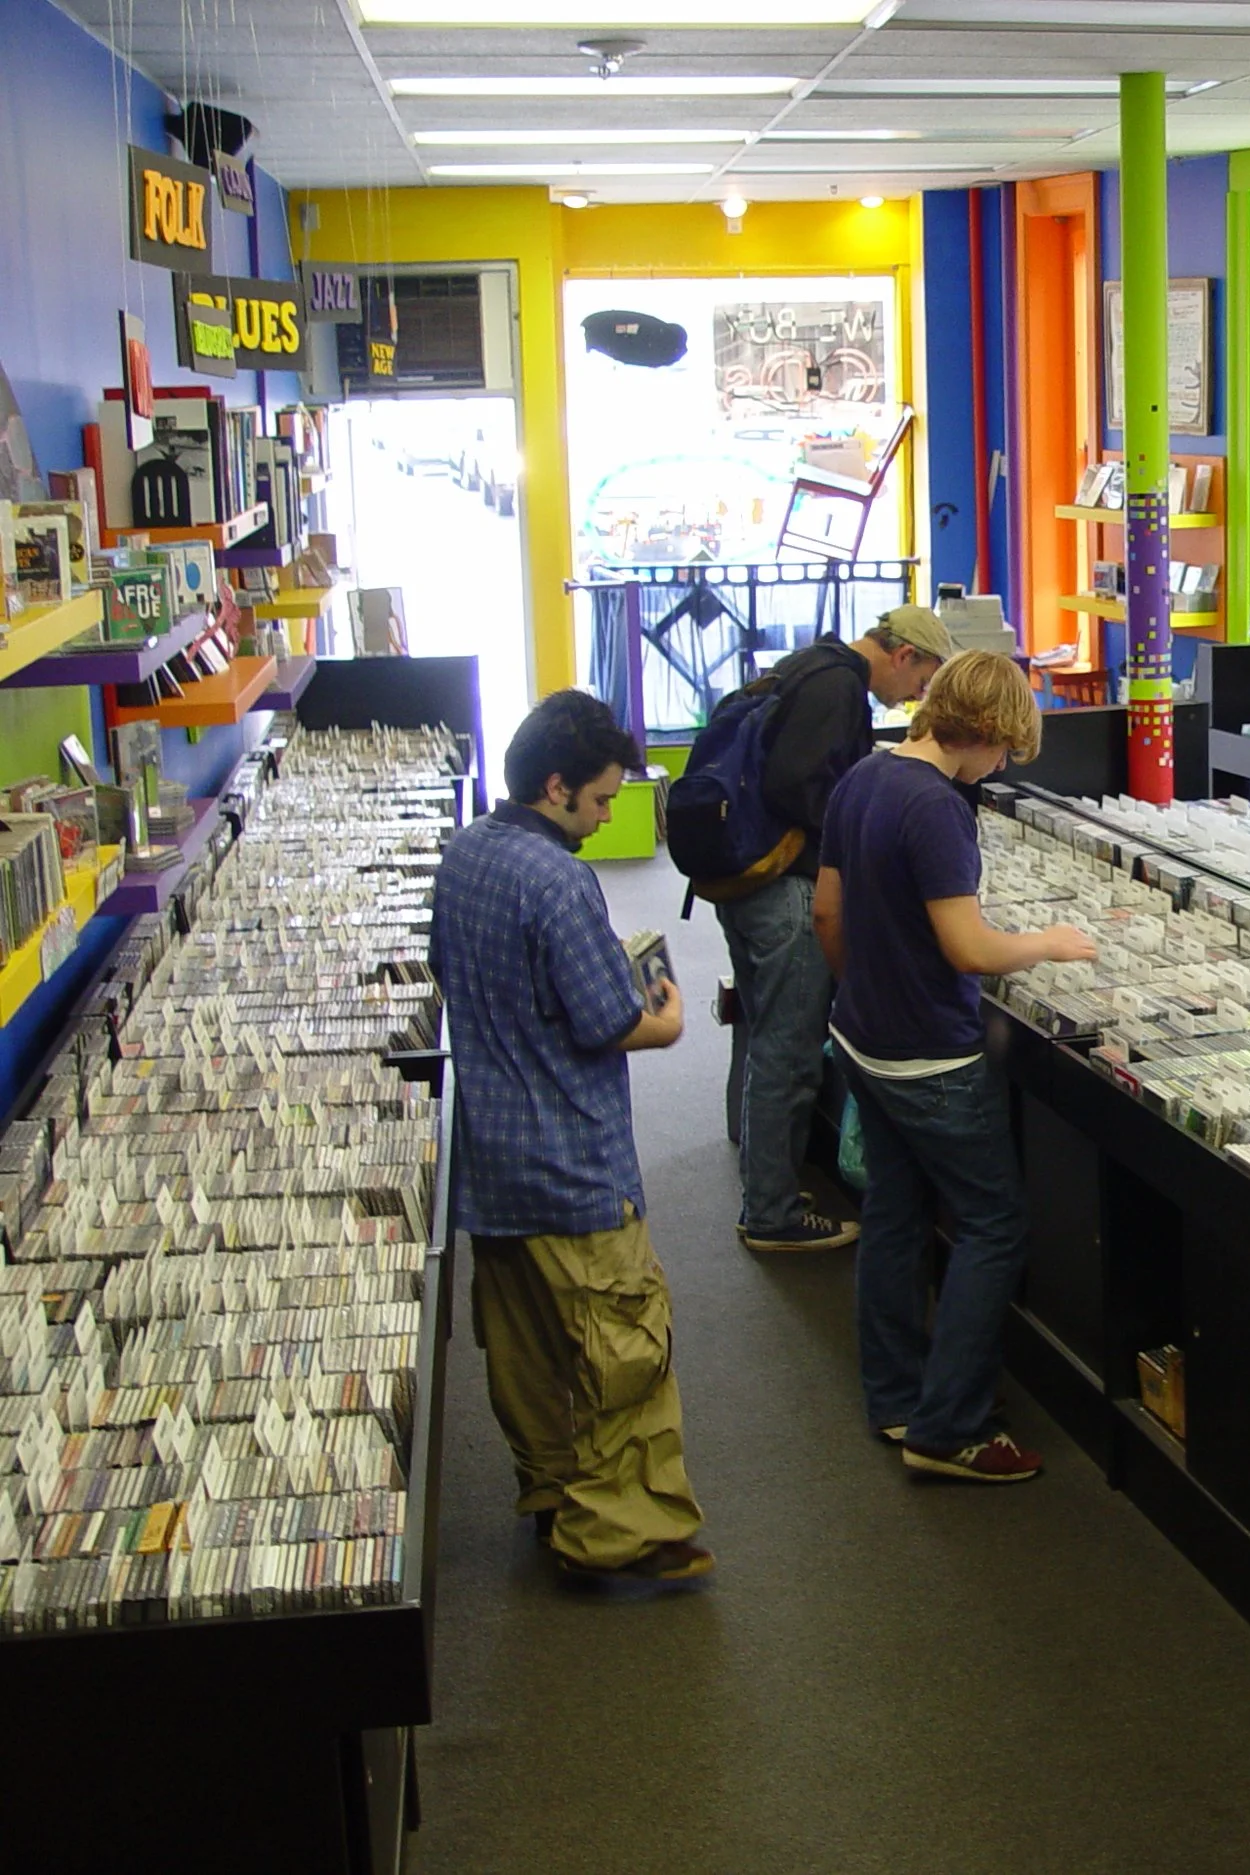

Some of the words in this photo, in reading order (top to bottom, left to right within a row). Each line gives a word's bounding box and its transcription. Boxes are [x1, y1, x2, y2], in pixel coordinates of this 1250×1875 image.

[144, 169, 206, 250] FOLK
[312, 272, 357, 311] JAZZ
[191, 292, 299, 353] UES
[371, 342, 396, 360] NEW
[373, 359, 394, 375] AGE
